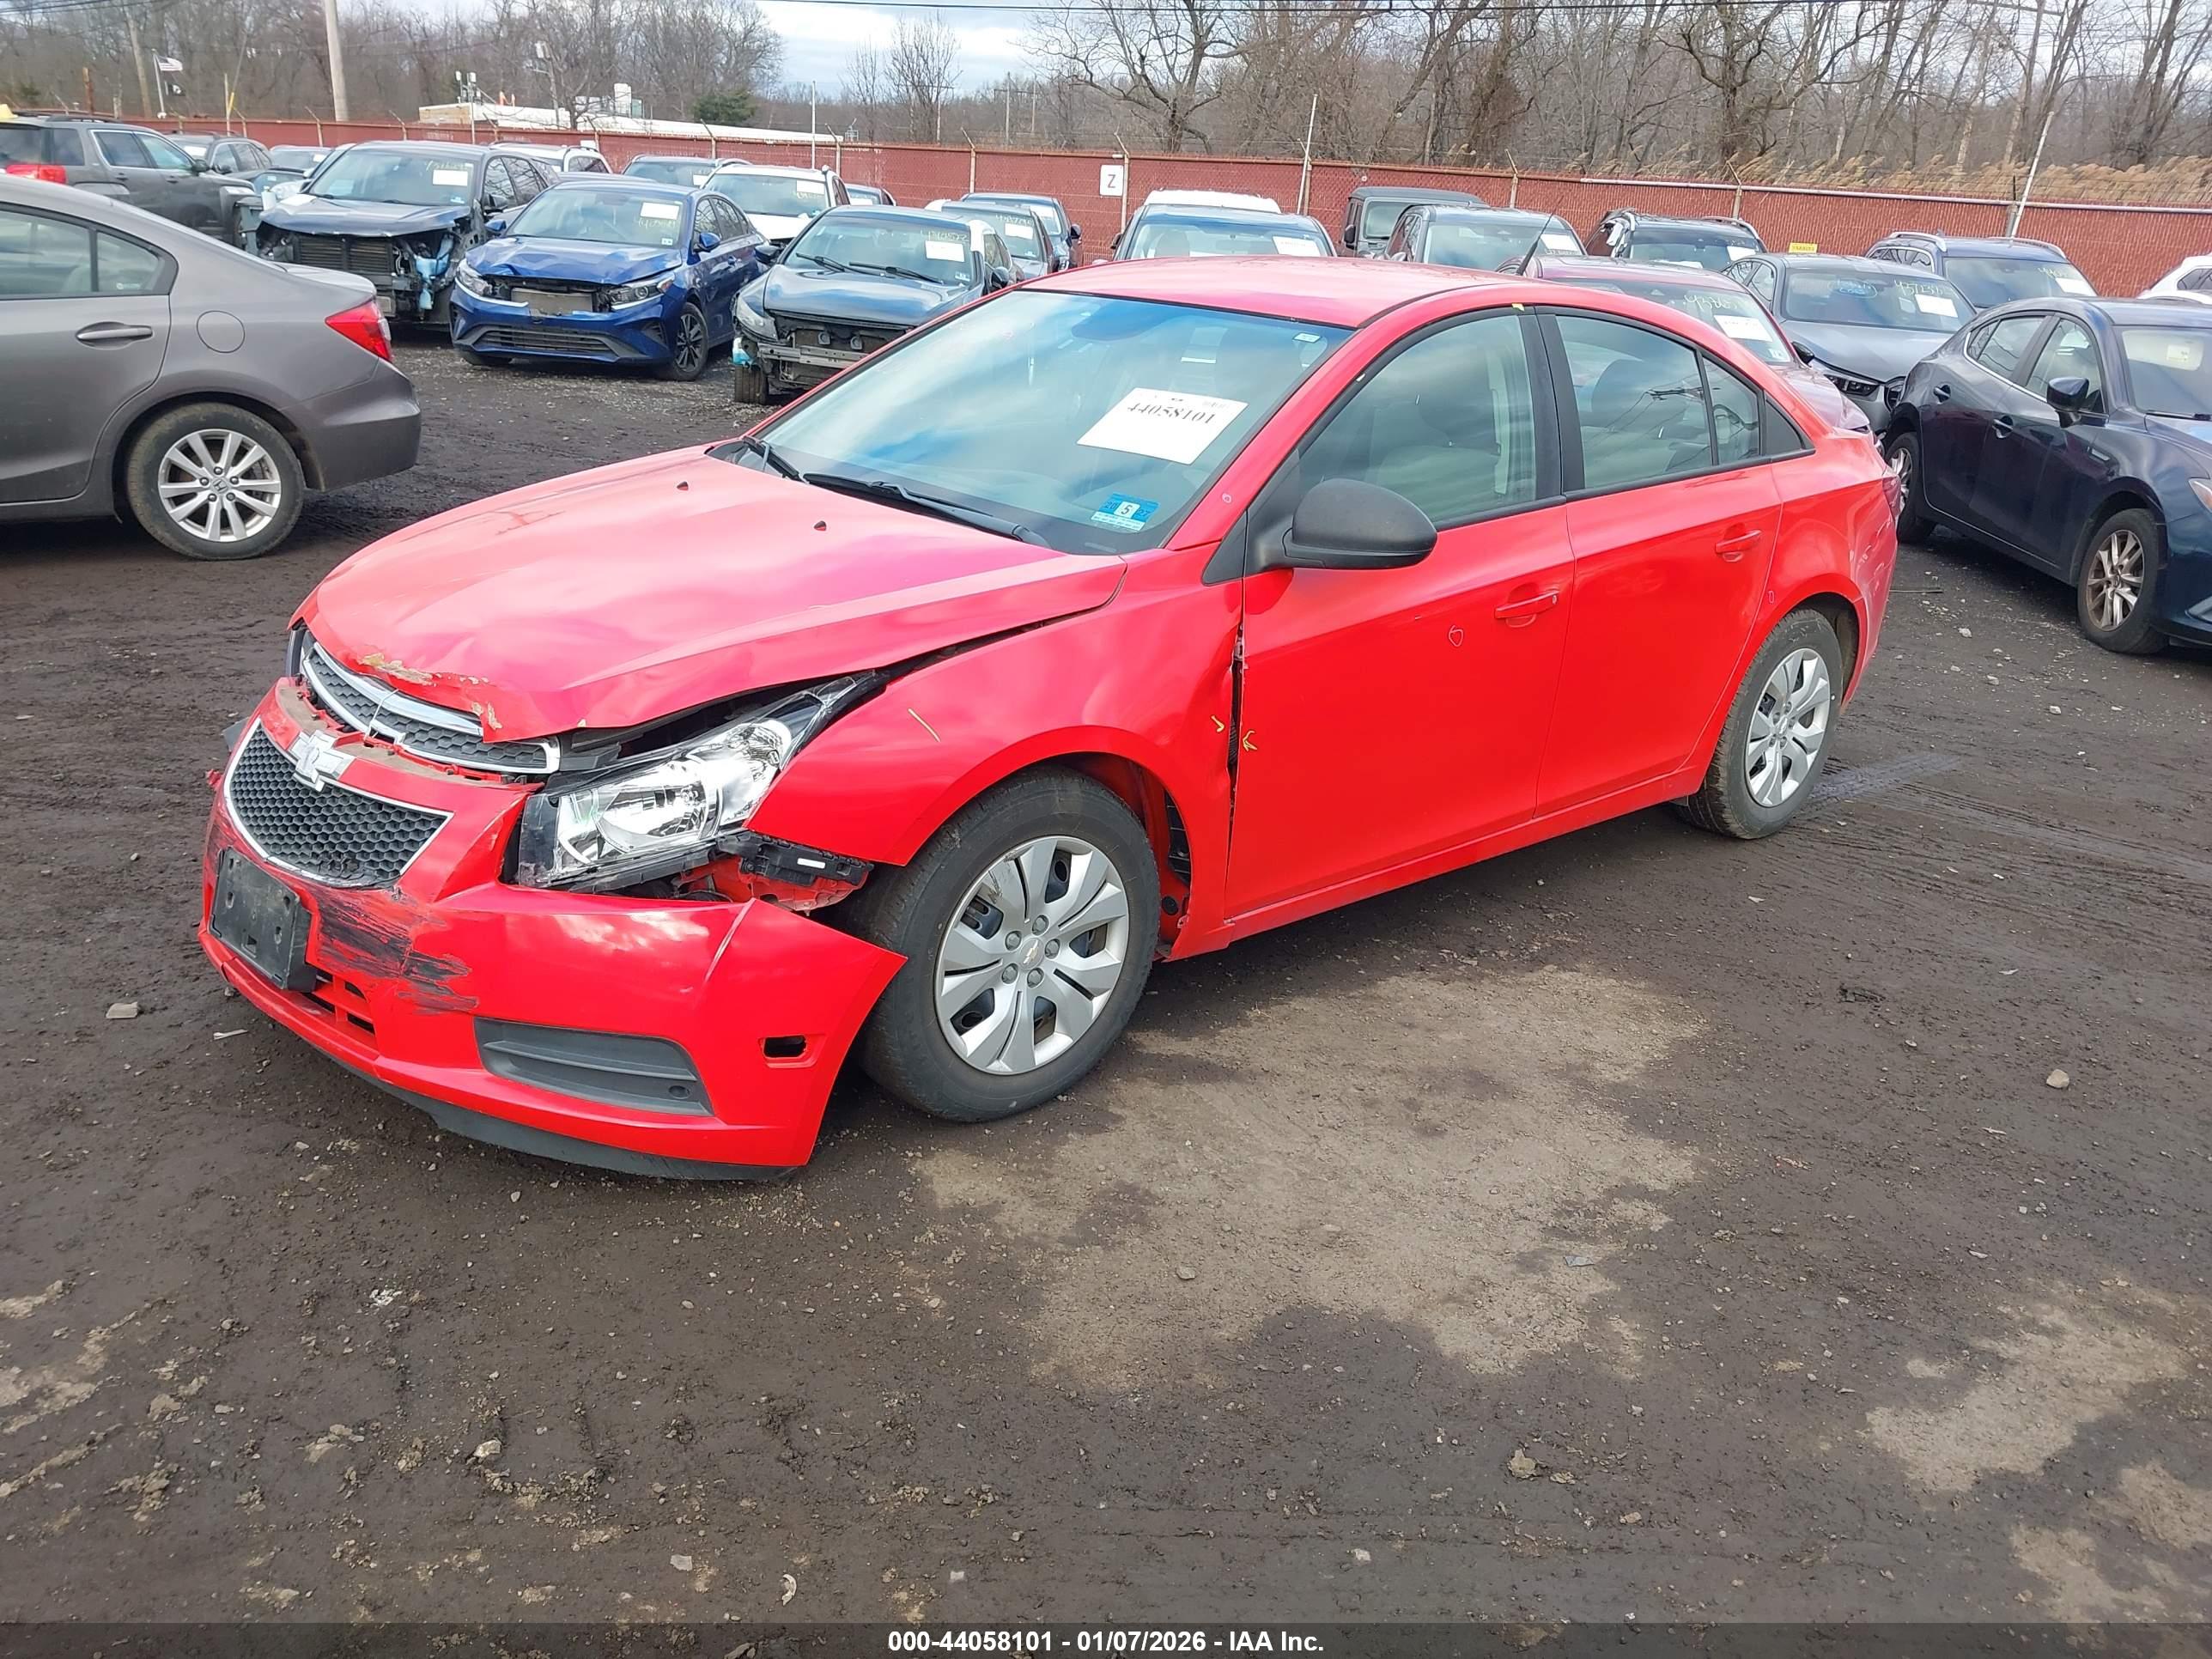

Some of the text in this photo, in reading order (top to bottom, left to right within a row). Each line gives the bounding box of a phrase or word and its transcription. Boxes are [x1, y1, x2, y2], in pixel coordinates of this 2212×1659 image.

[1107, 173, 1116, 189] Z
[1127, 403, 1215, 424] 44058101
[1121, 504, 1133, 515] 5
